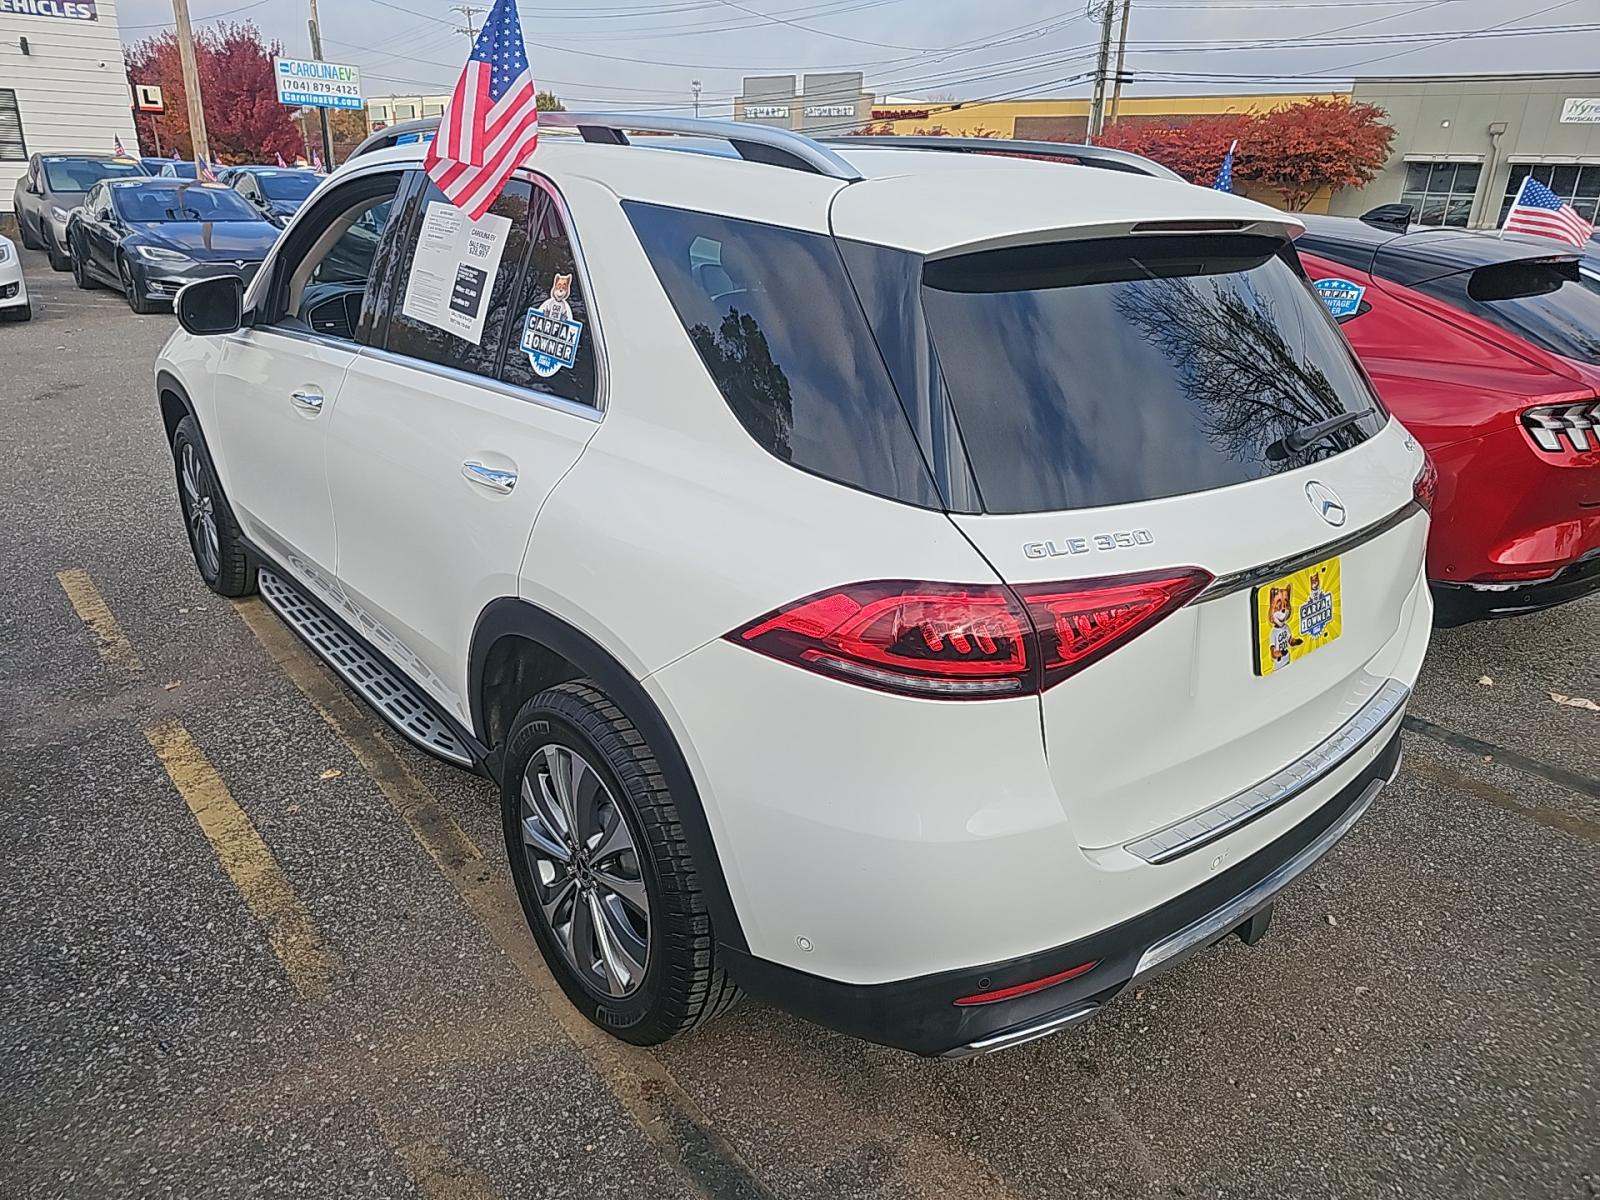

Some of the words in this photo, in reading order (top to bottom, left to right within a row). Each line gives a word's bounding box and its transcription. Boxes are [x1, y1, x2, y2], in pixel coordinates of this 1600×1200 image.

[283, 79, 309, 92] (704)
[313, 83, 358, 95] 879-4125
[529, 316, 576, 343] CARFAX
[1023, 538, 1090, 559] GLE
[1093, 528, 1154, 550] 350
[1301, 597, 1332, 618] CARFAX
